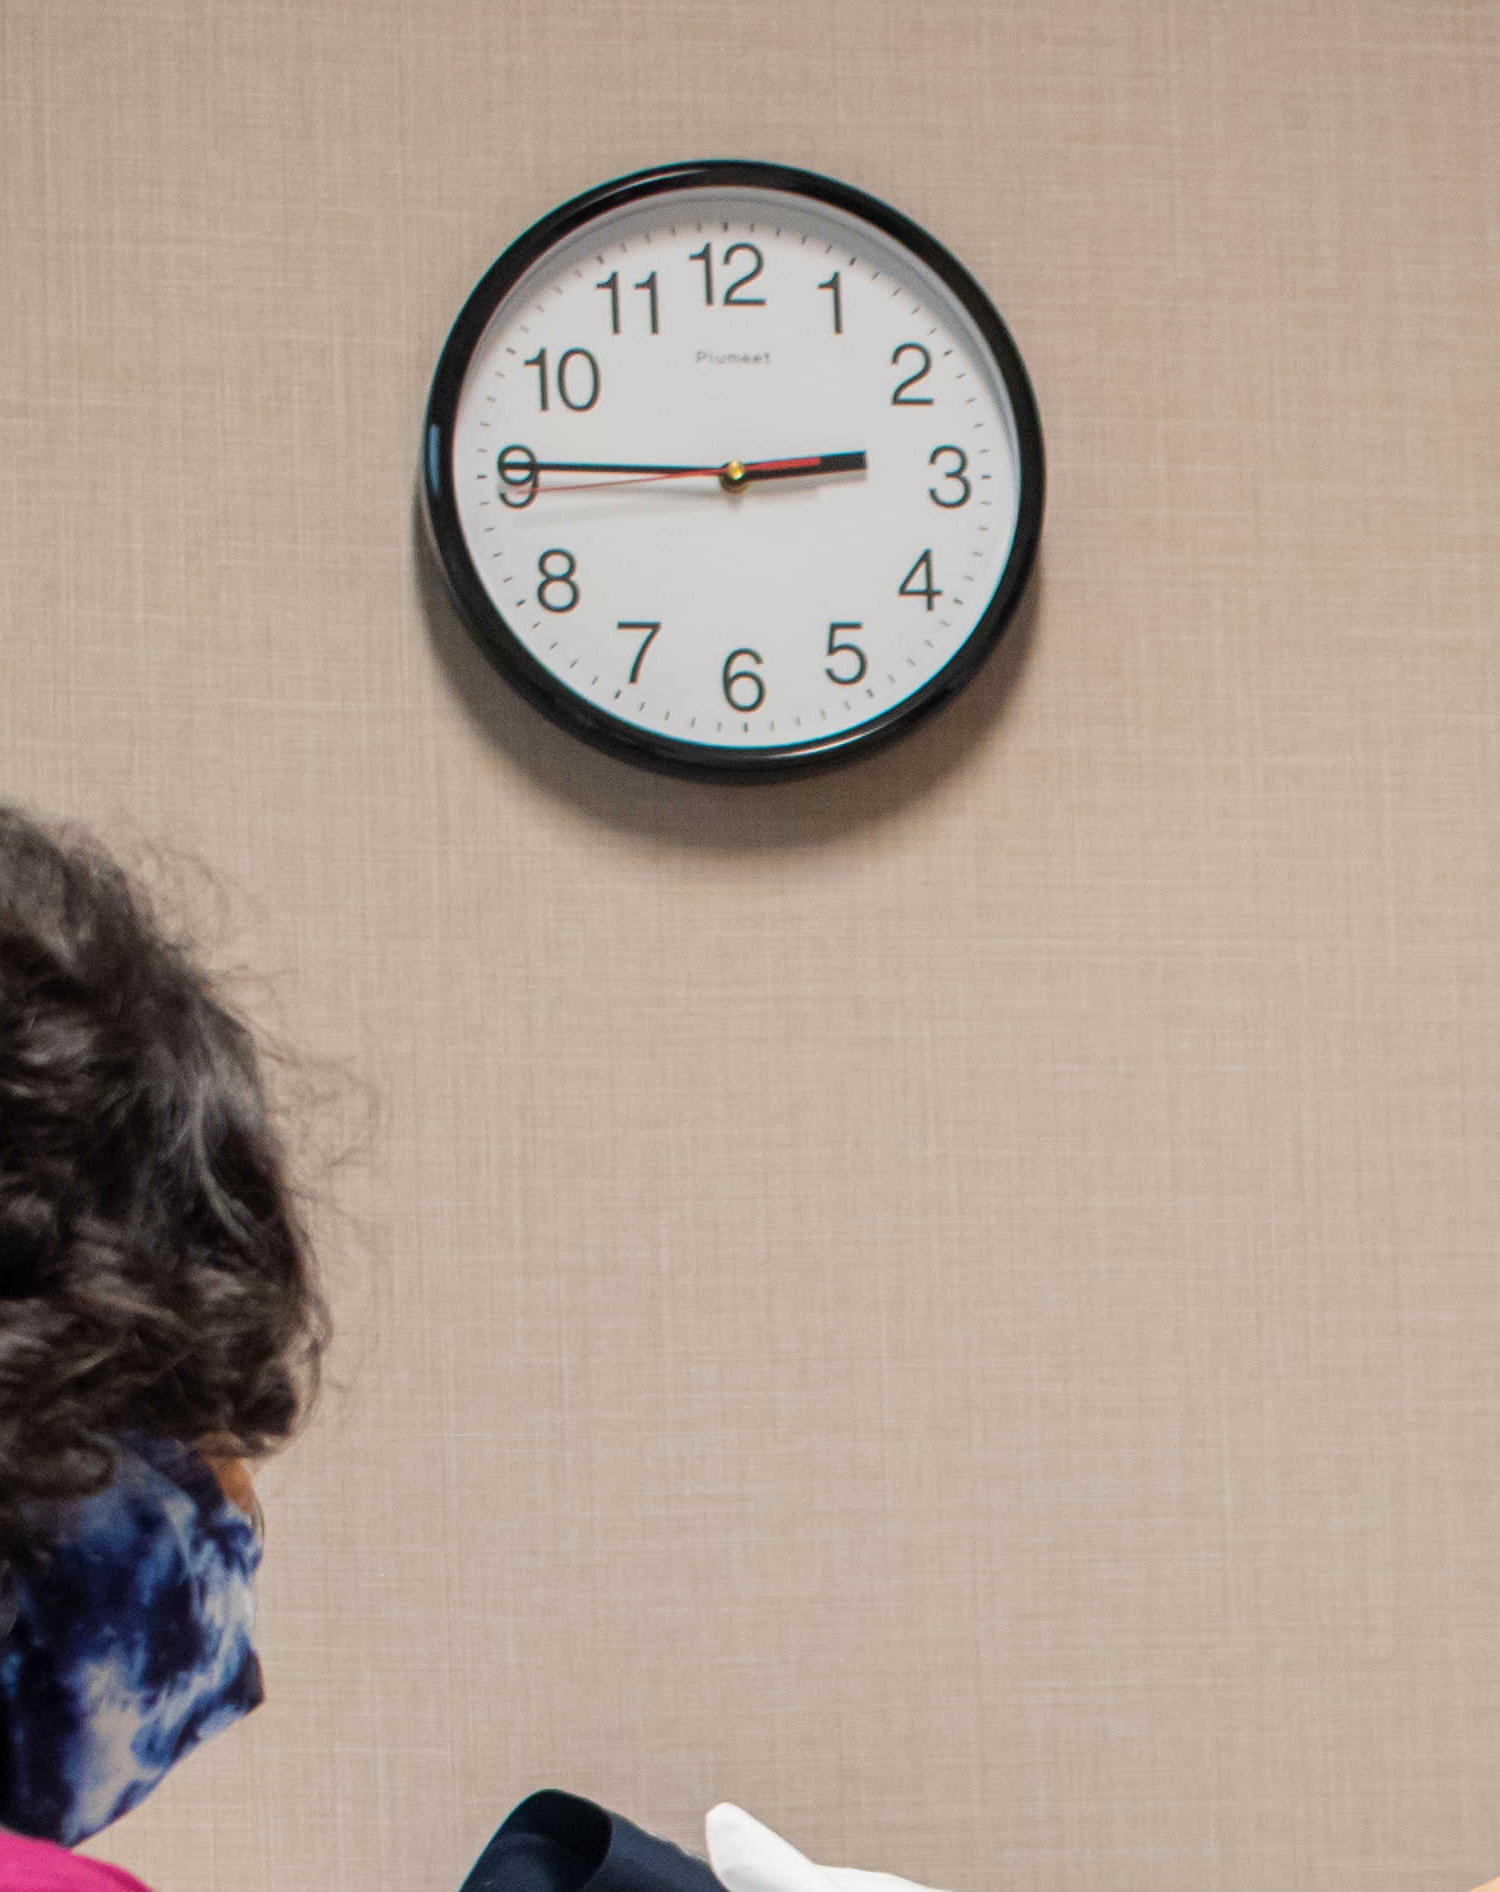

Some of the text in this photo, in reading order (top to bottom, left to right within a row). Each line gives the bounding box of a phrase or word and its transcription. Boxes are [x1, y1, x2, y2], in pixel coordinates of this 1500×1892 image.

[595, 269, 660, 336] 11
[689, 241, 767, 306] 12
[817, 270, 844, 336] 1
[523, 347, 601, 412] 10
[890, 340, 934, 406] 2
[497, 443, 540, 510] 9
[928, 443, 973, 510] 3
[536, 547, 581, 614] 8
[898, 547, 944, 612] 4
[615, 620, 662, 685] 7
[721, 647, 767, 714] 6
[825, 621, 869, 686] 5
